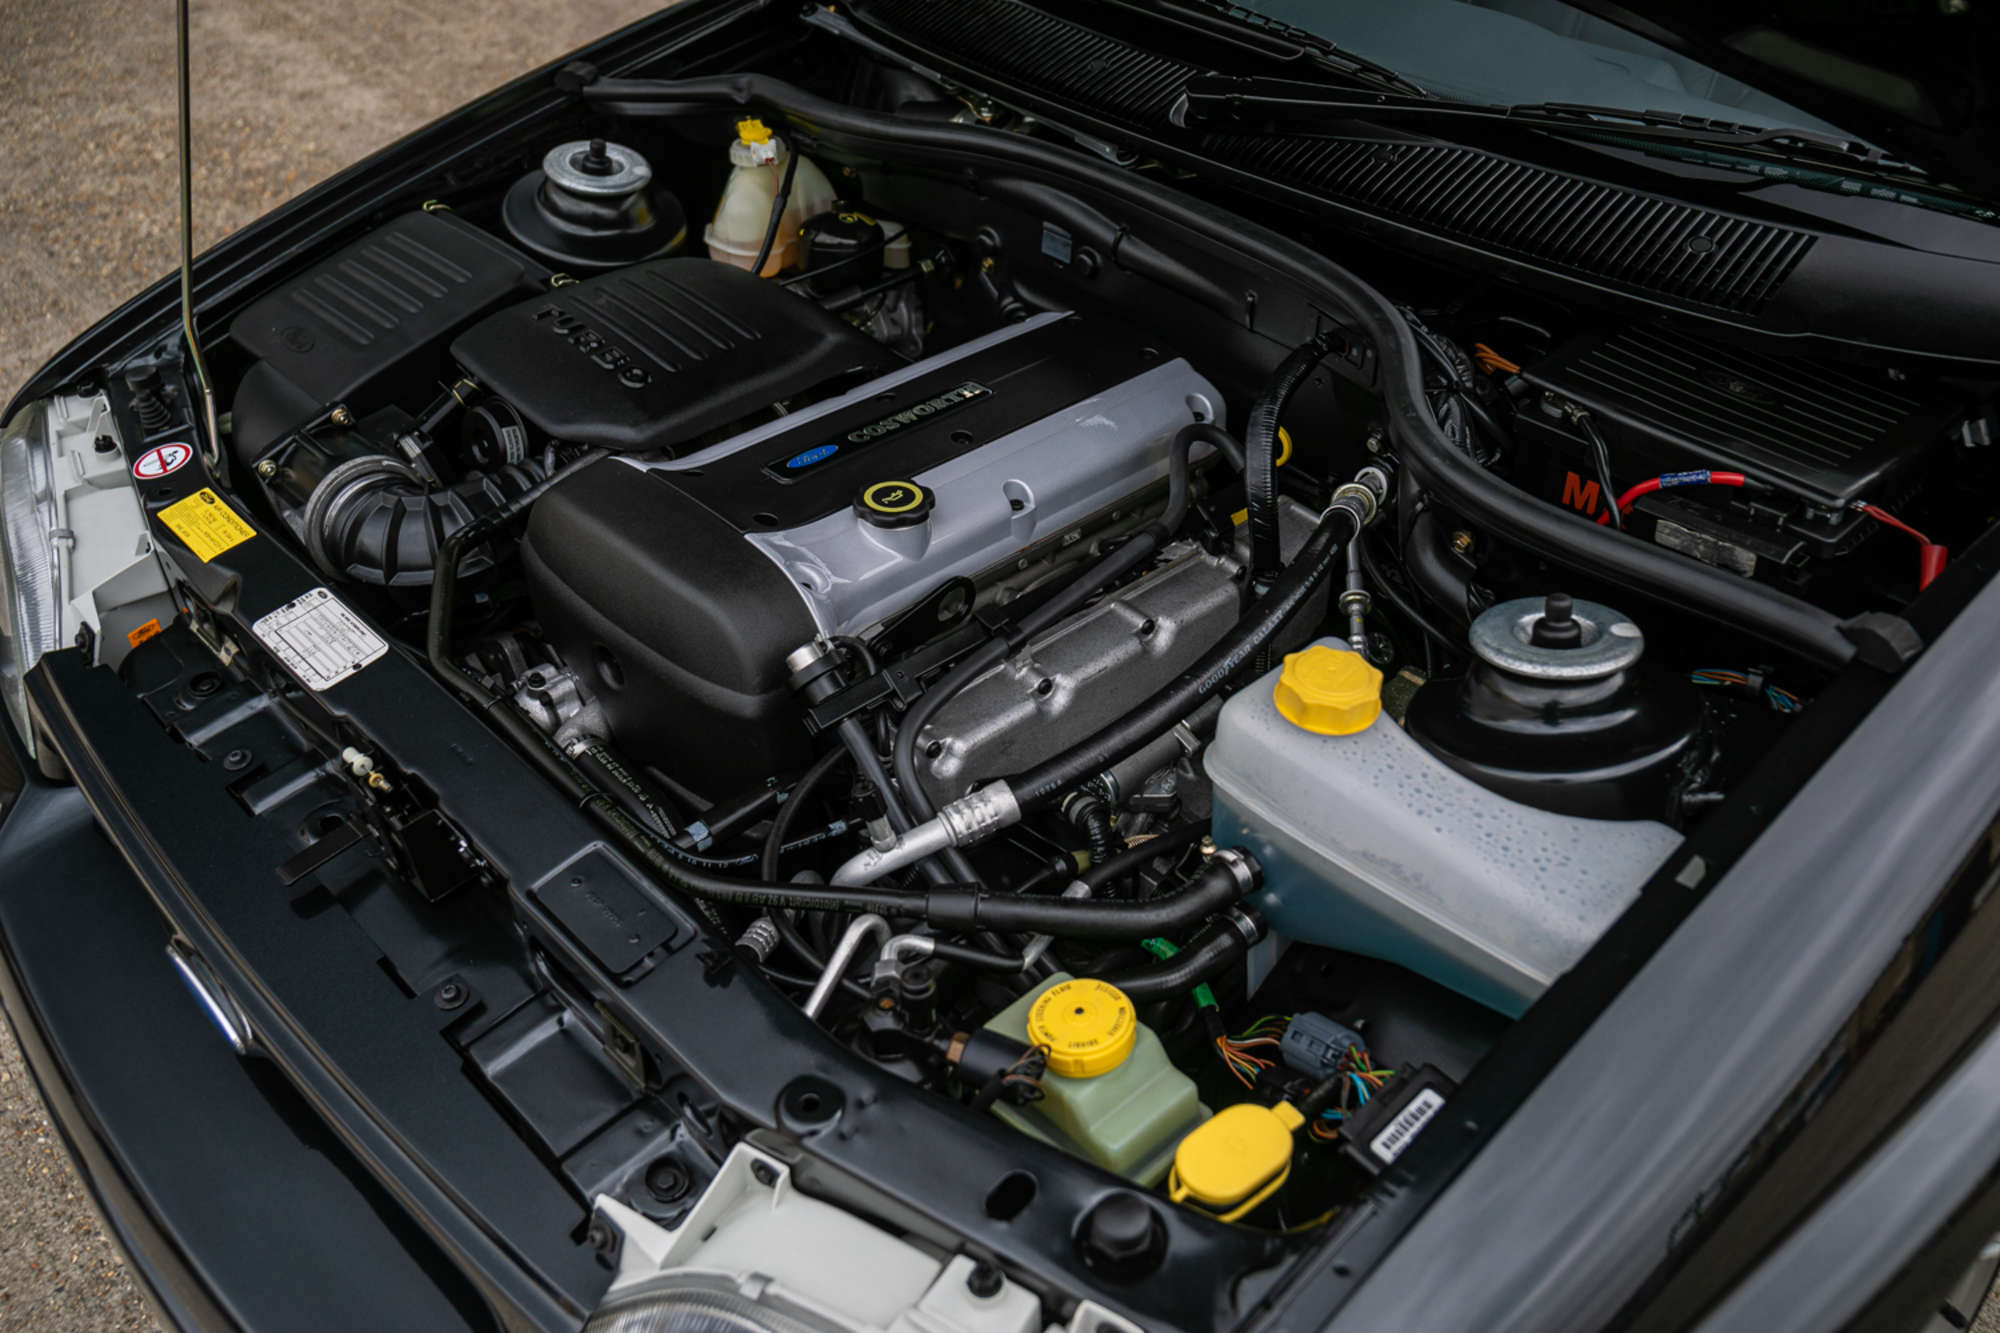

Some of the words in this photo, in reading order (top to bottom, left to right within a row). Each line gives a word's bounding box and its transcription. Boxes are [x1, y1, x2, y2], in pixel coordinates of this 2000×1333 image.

[532, 304, 652, 388] TURBO
[848, 382, 984, 443] COSWORTH
[1199, 642, 1251, 694] GOODYEAR
